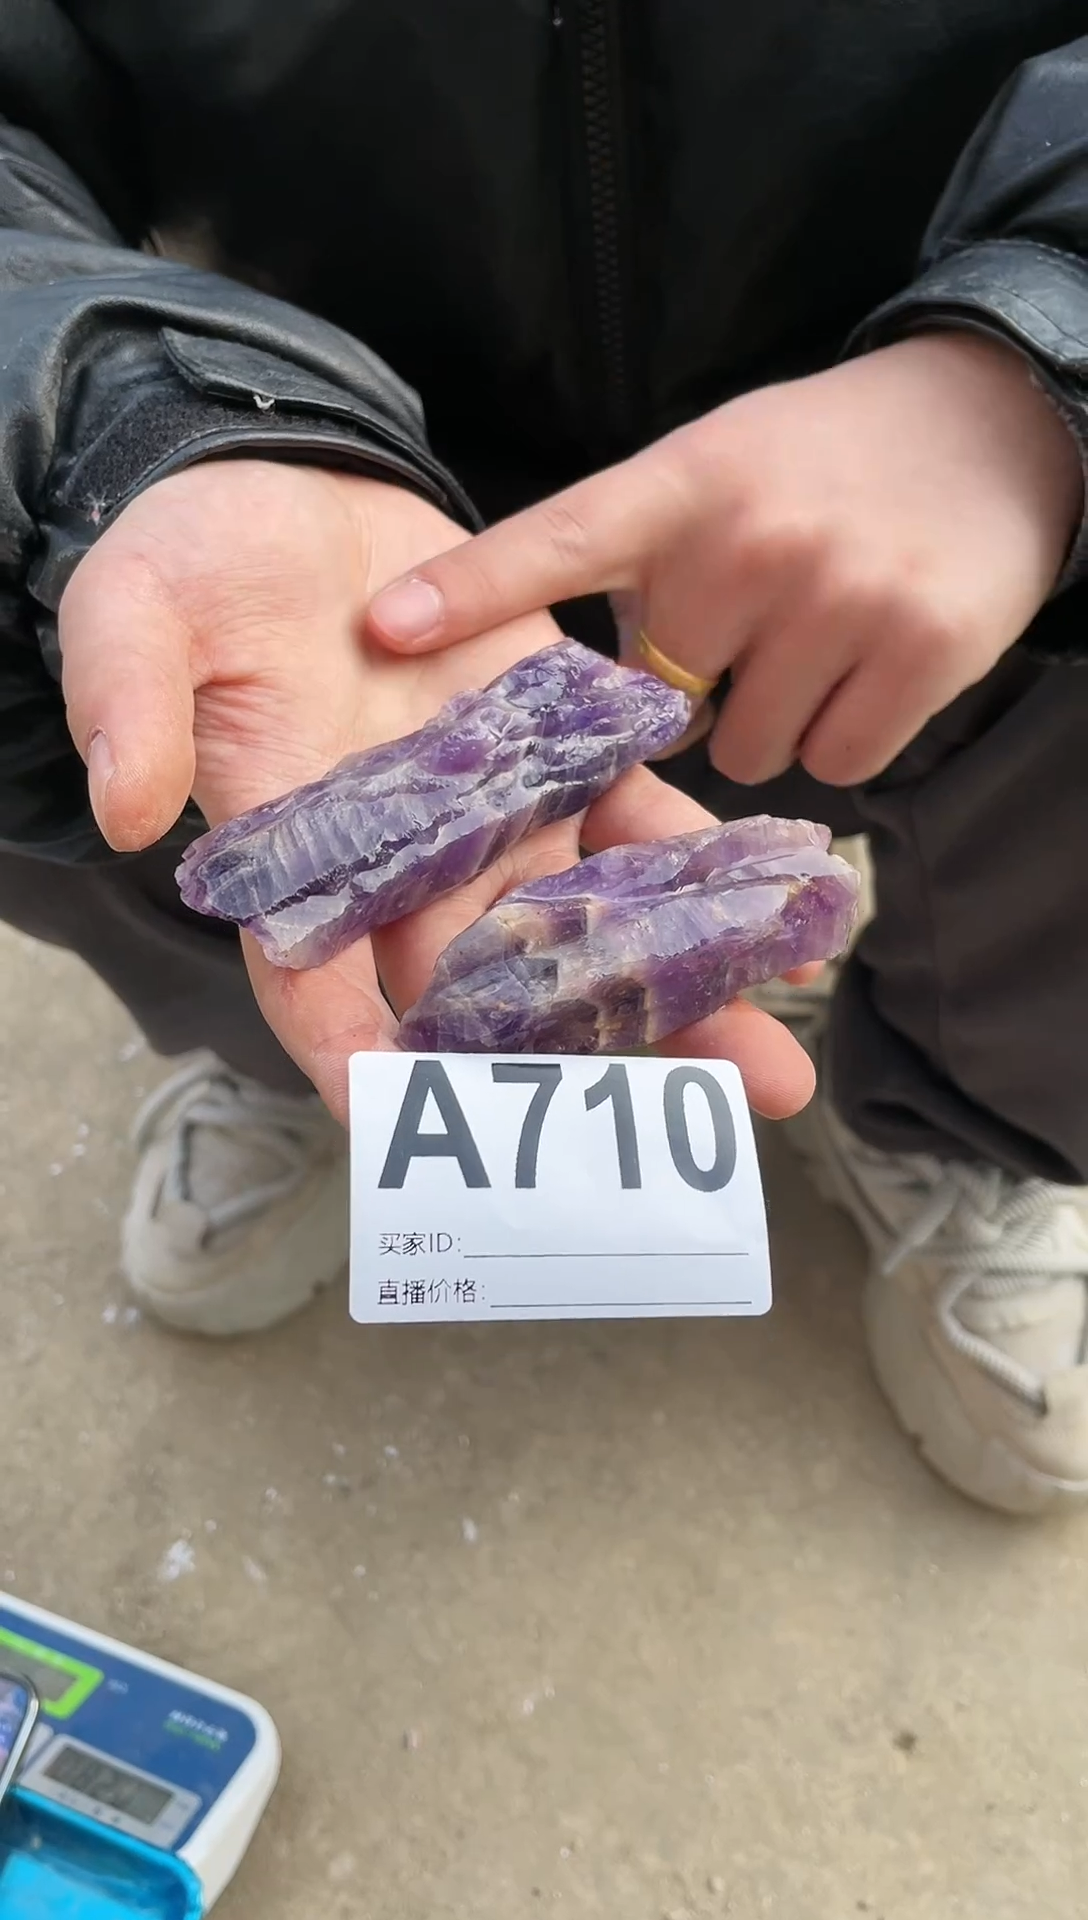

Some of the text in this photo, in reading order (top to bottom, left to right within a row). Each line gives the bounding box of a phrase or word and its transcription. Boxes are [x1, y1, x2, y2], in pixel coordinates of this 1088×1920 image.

[377, 1060, 737, 1192] A710
[378, 1232, 462, 1255] 买家ID:
[377, 1278, 486, 1305] 直播价格:
